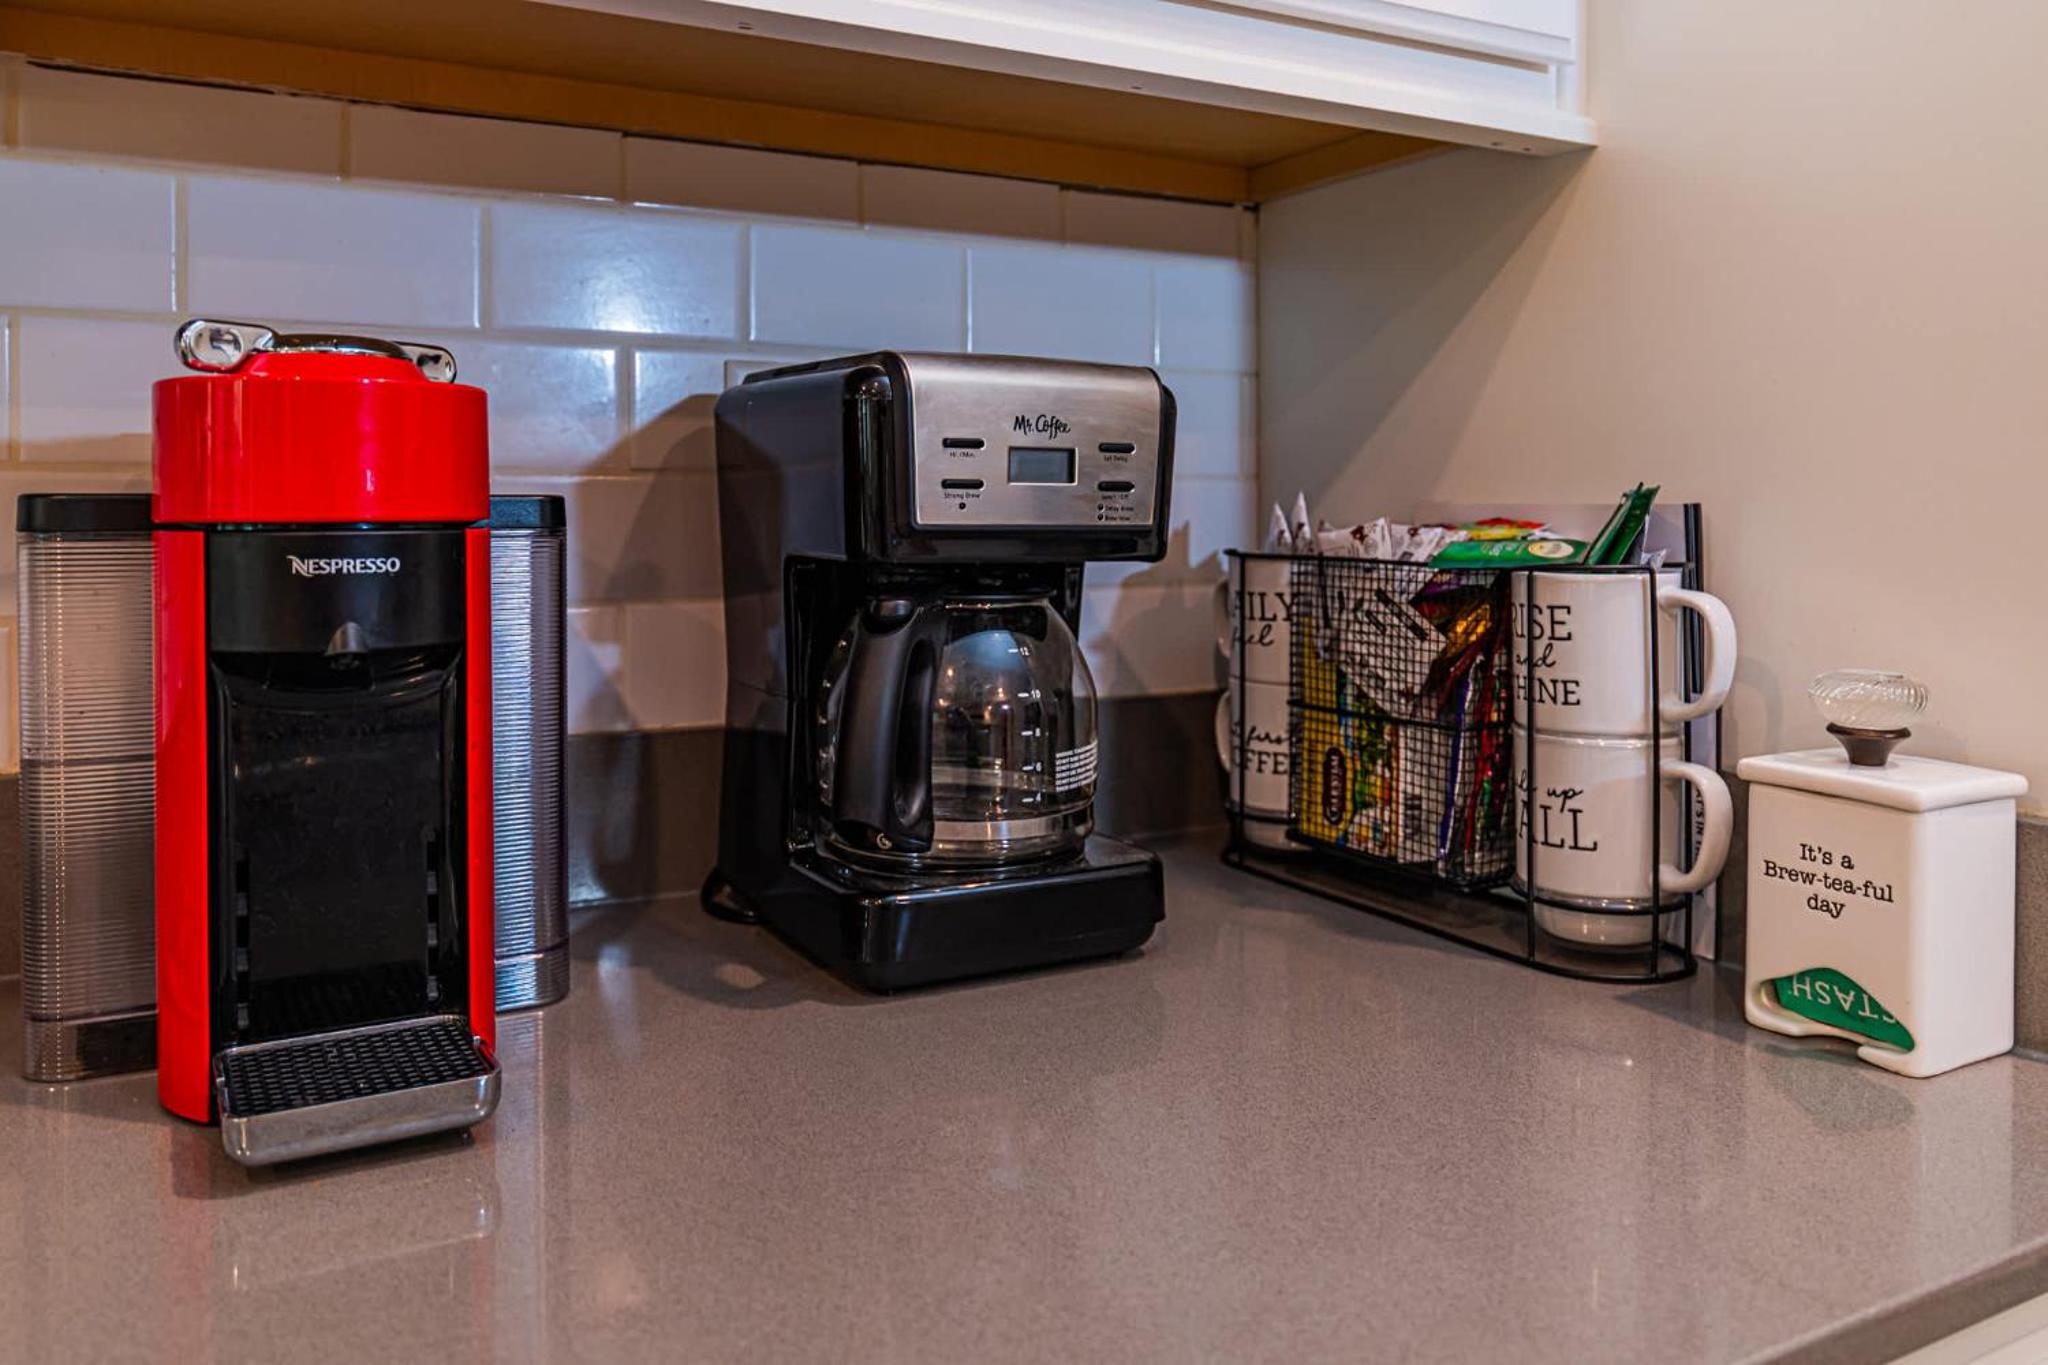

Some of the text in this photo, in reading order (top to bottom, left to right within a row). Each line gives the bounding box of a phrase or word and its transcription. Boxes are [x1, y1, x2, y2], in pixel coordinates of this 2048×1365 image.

[1013, 413, 1071, 440] Mr. Coffee
[286, 555, 401, 577] NESPRESSO
[1020, 646, 1030, 656] 12
[1031, 689, 1041, 699] 10
[1516, 674, 1581, 706] HNE
[1547, 787, 1584, 813] up
[1799, 843, 1855, 870] It's a
[1763, 859, 1895, 903] Brew-tea-ful
[1807, 894, 1846, 919] day
